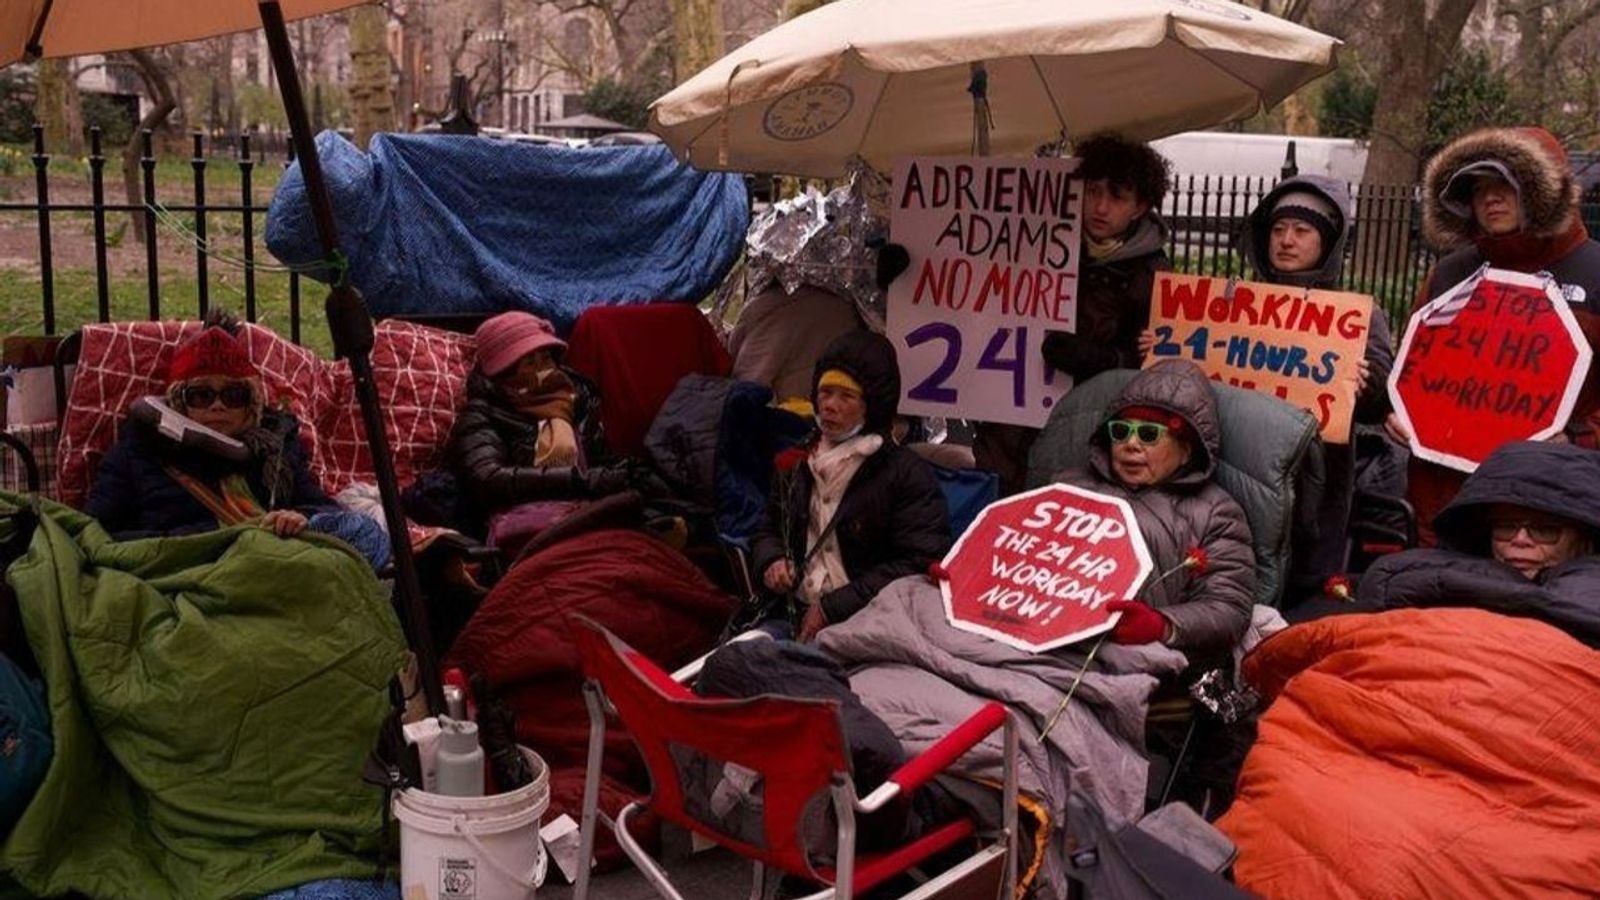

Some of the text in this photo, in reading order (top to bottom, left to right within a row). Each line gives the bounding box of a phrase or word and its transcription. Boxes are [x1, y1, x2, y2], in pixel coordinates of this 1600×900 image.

[901, 161, 1081, 220] ADRIENNE
[935, 212, 1072, 269] ADAMS
[912, 257, 1077, 323] NO MORE
[1160, 278, 1366, 340] WORKING
[1470, 283, 1554, 325] STOP
[1445, 324, 1488, 359] 24
[1495, 328, 1550, 374] HR
[1419, 370, 1558, 423] WORKDAY
[1022, 501, 1126, 544] STOP
[994, 525, 1118, 582] THE 24 HR
[977, 584, 1063, 626] NOW!
[991, 555, 1116, 610] WORKDAY
